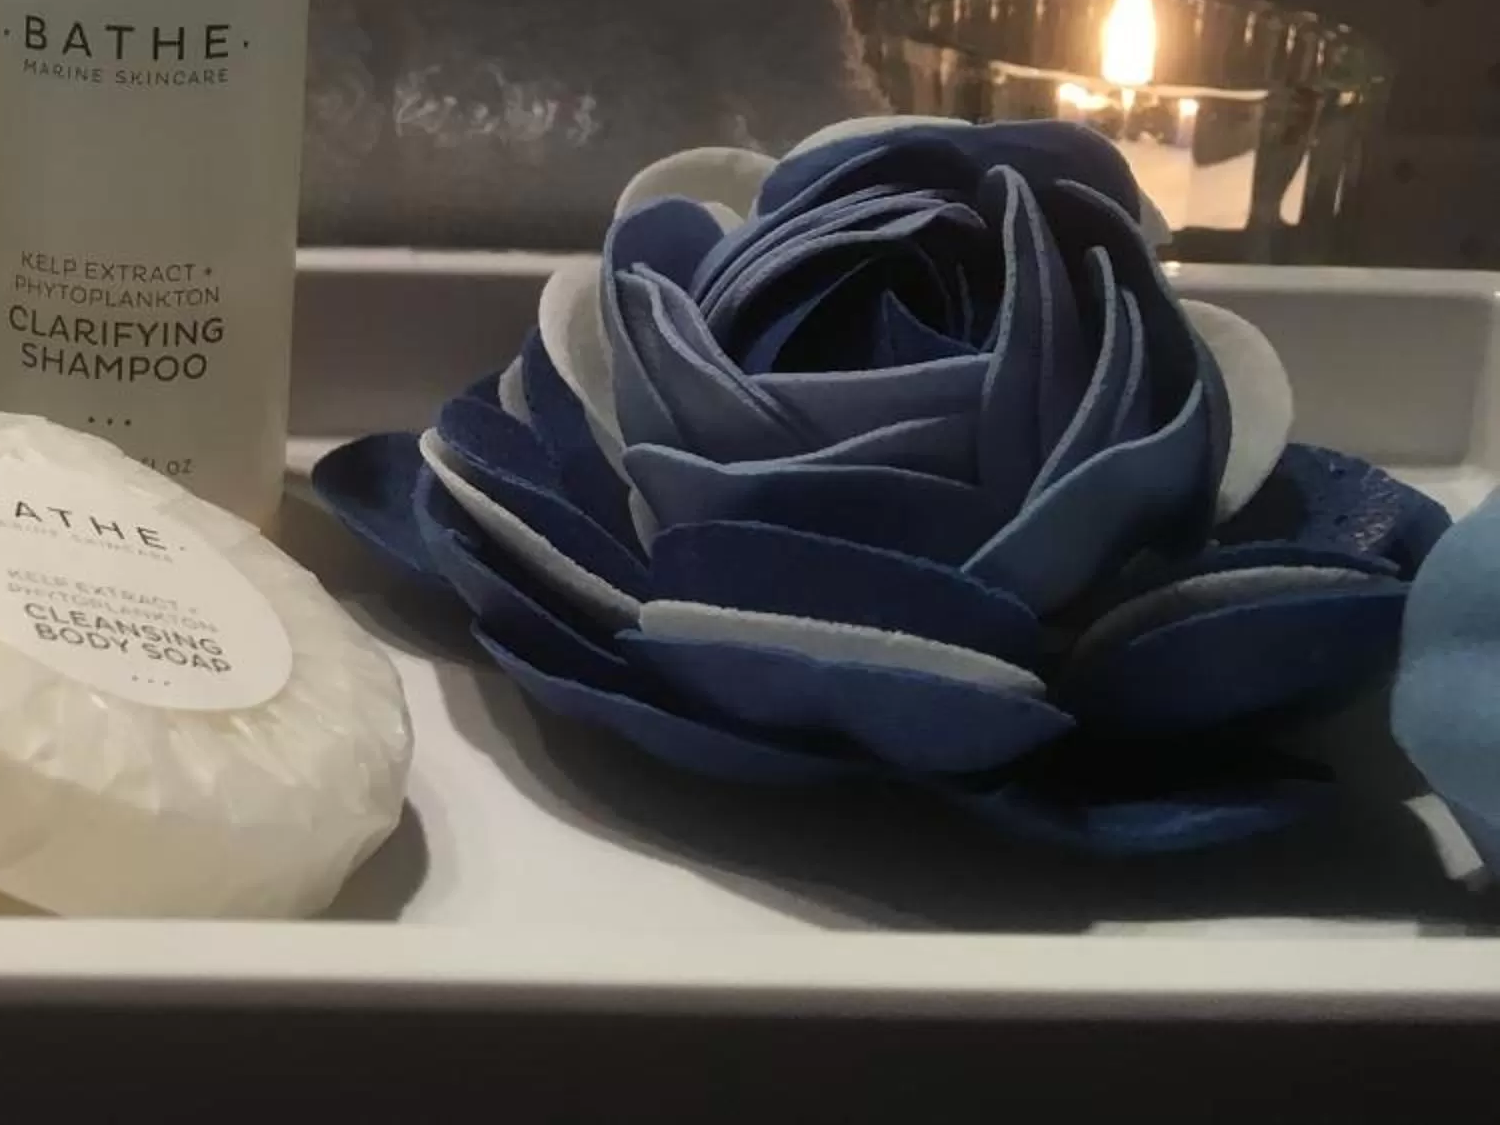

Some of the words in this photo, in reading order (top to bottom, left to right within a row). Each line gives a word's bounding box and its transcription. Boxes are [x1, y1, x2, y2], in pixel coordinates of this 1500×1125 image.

[25, 15, 231, 61] BATHE
[23, 58, 102, 83] MARINE
[115, 68, 229, 86] SKINCARE
[21, 250, 77, 275] KELP
[85, 262, 196, 283] EXTRACT
[14, 274, 220, 308] PHYTOPLANKTON
[8, 304, 224, 348] CLARIFYING
[21, 342, 207, 382] SHAMPOO
[24, 602, 223, 656] CLEANSING
[35, 622, 130, 654] BODY
[141, 642, 232, 673] SOAP
